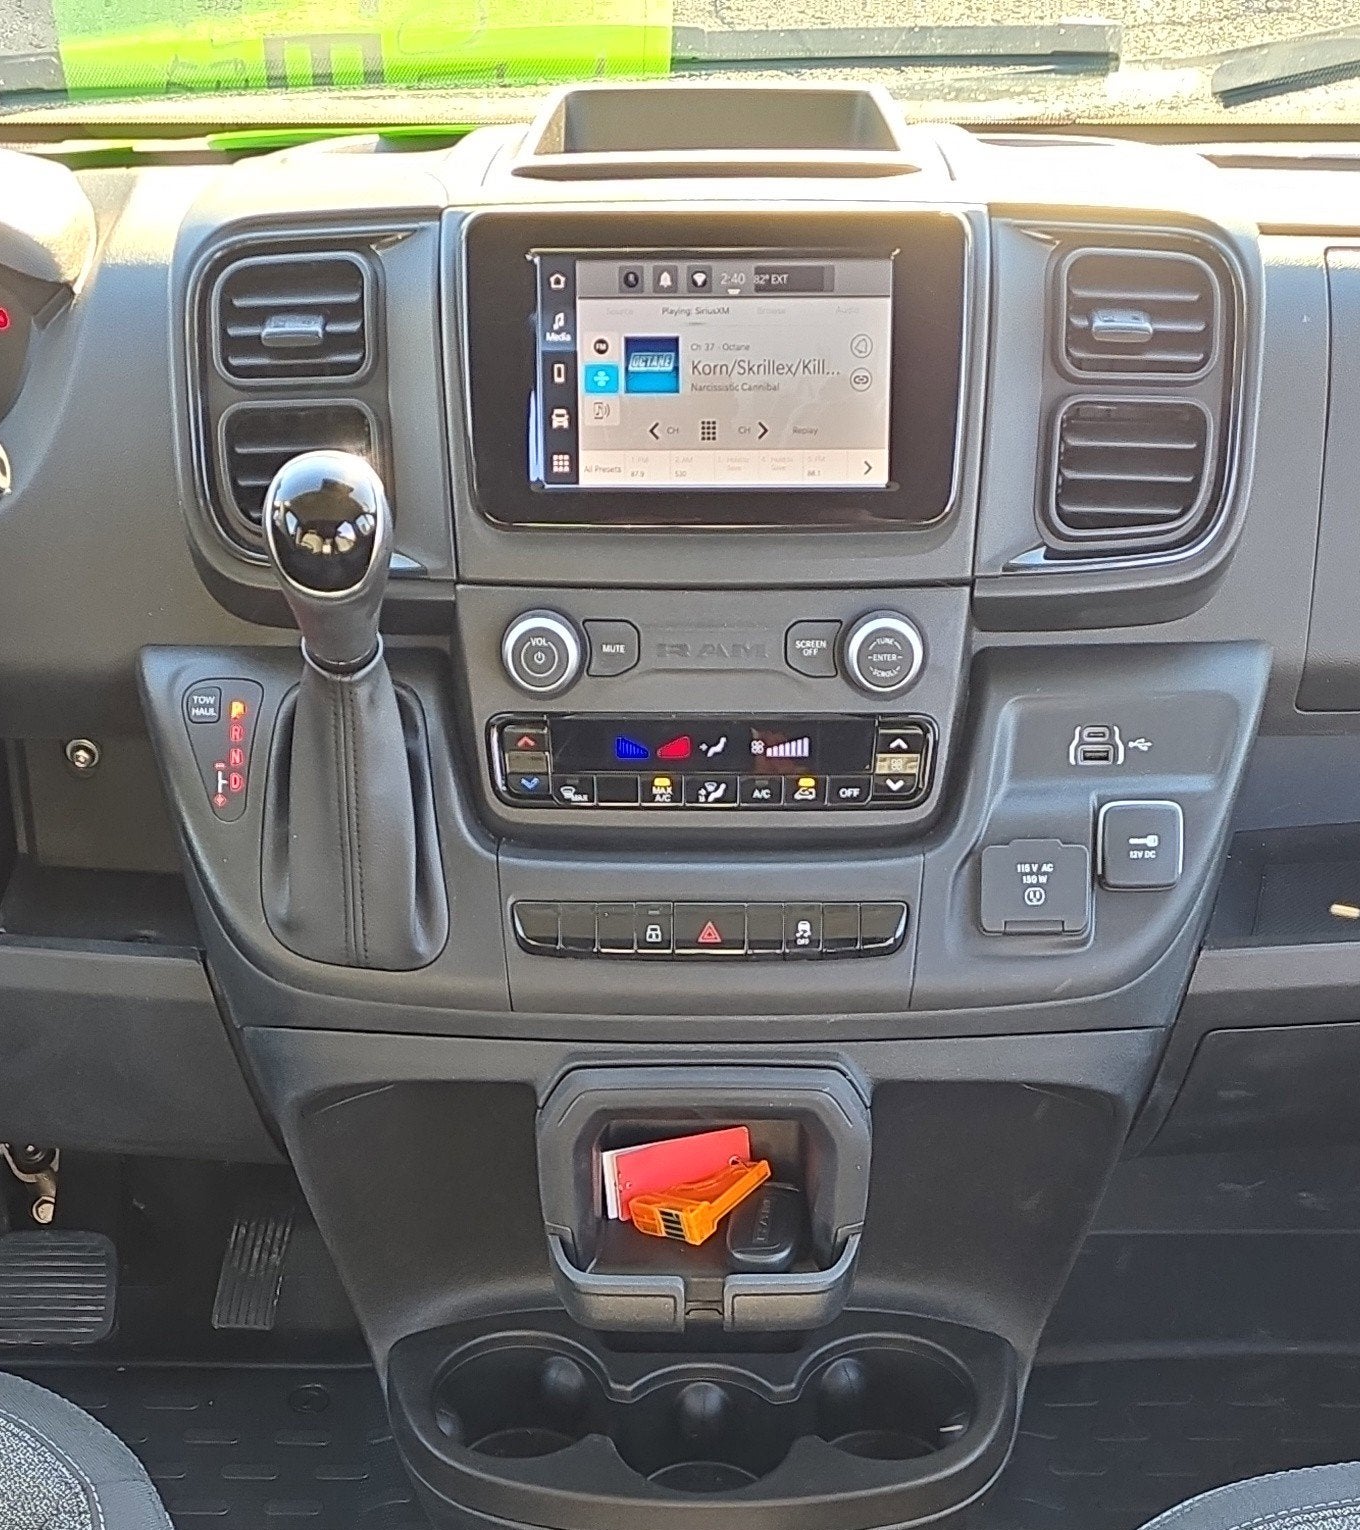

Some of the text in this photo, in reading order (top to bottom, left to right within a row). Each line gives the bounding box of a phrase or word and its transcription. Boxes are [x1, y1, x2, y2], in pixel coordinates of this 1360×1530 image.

[721, 273, 746, 285] 2:40
[771, 274, 788, 284] EXT
[694, 305, 730, 315] SiriusXM
[546, 332, 572, 342] Media
[704, 343, 715, 351] 37
[722, 343, 750, 351] Octane
[691, 358, 840, 377] Korn/Skrillex/Kill...
[691, 382, 779, 391] Narcissistic Cannibal
[530, 638, 548, 646] VOL
[795, 640, 827, 649] SCREEN
[602, 644, 625, 653] MUTE
[656, 643, 769, 658] RAM
[872, 653, 897, 661] ENTER
[193, 695, 215, 704] TOW
[191, 707, 217, 716] HAUL
[230, 725, 244, 742] R
[230, 748, 244, 766] N
[230, 772, 242, 791] D
[652, 786, 673, 795] MAX
[752, 788, 771, 799] A/C
[839, 788, 860, 798] OFF
[1145, 850, 1156, 858] DC
[1041, 863, 1054, 872] AC
